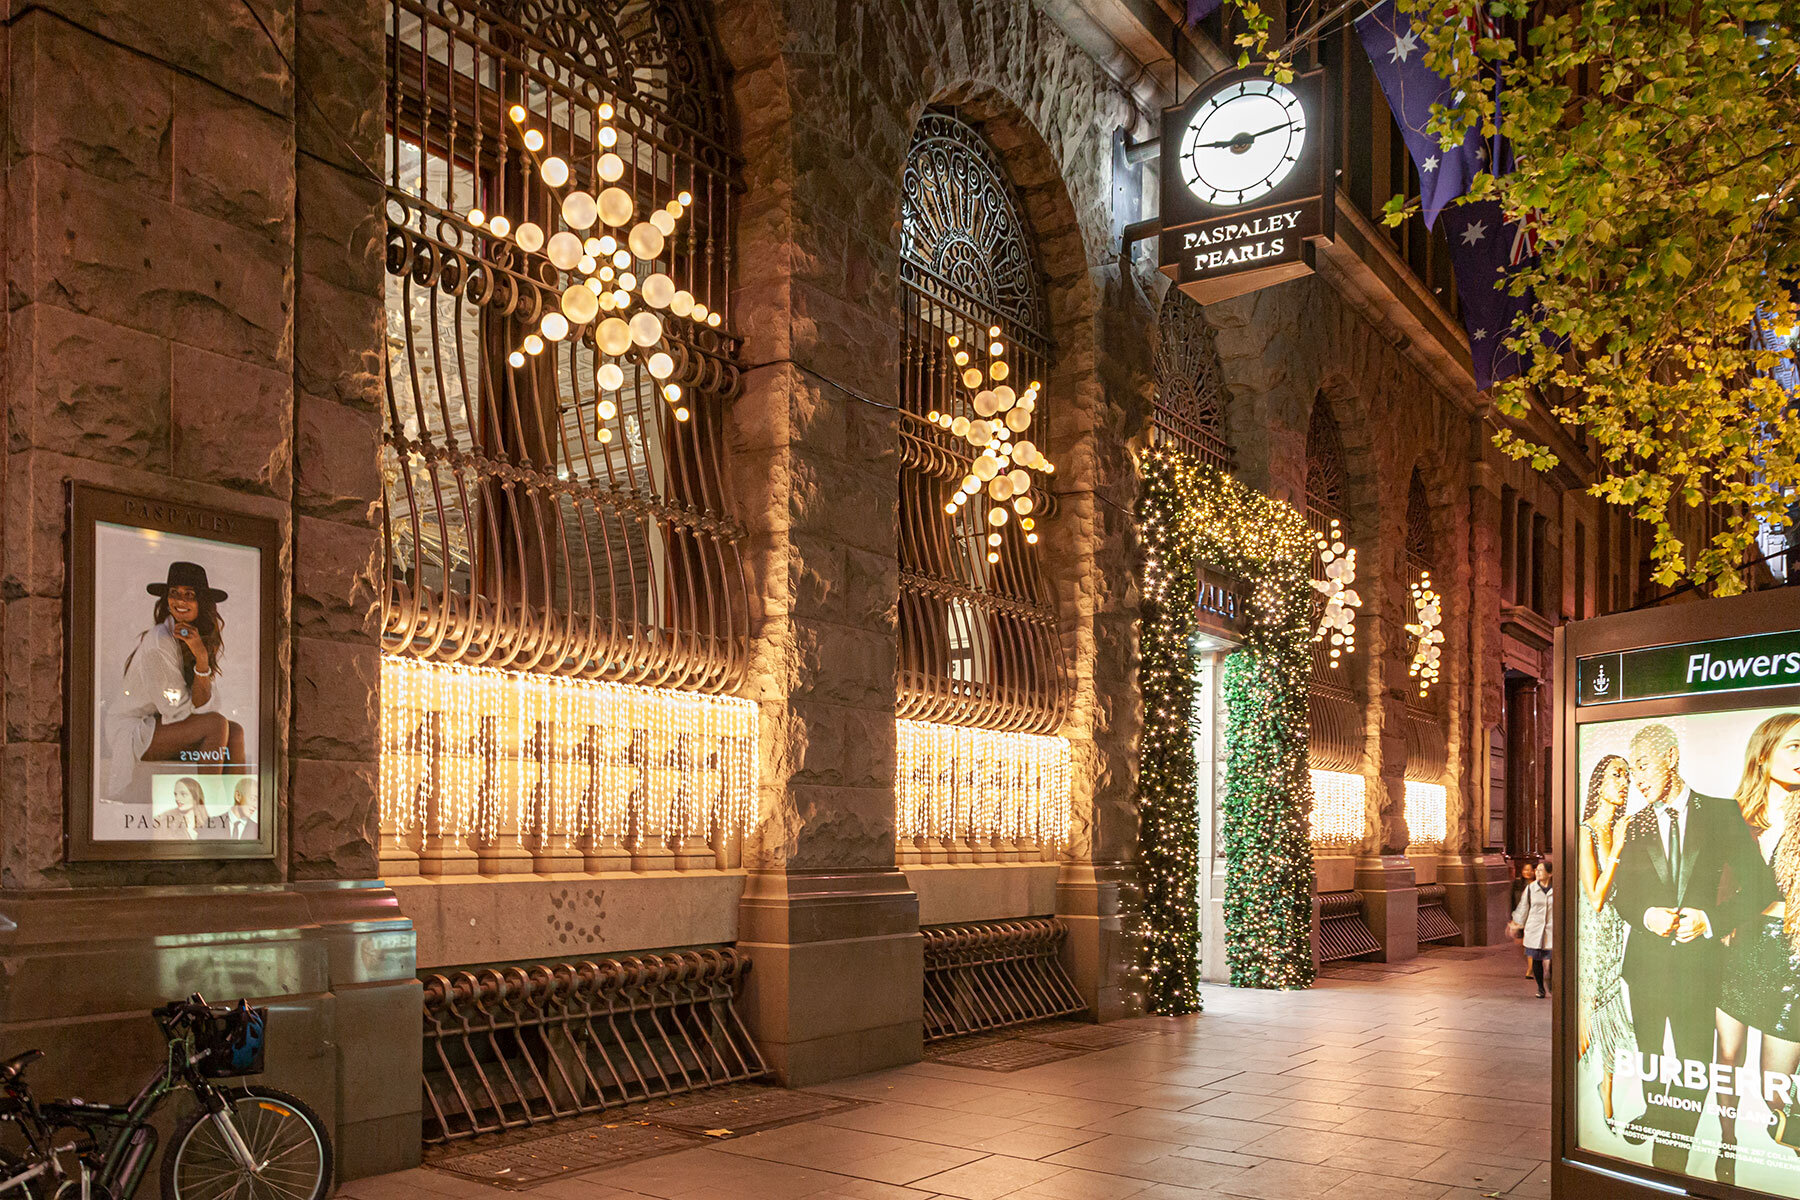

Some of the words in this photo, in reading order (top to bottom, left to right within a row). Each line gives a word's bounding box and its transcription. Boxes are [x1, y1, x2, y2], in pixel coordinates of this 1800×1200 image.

[1183, 210, 1302, 250] PASPALEY
[1194, 238, 1285, 271] PEARLS
[124, 499, 234, 535] PASPALEY
[1686, 652, 1800, 684] Flowers
[124, 814, 229, 829] PASPALEY
[1647, 1092, 1702, 1113] LONDON
[1707, 1103, 1778, 1126] ENGLAND
[1643, 1126, 1671, 1138] GEORGE
